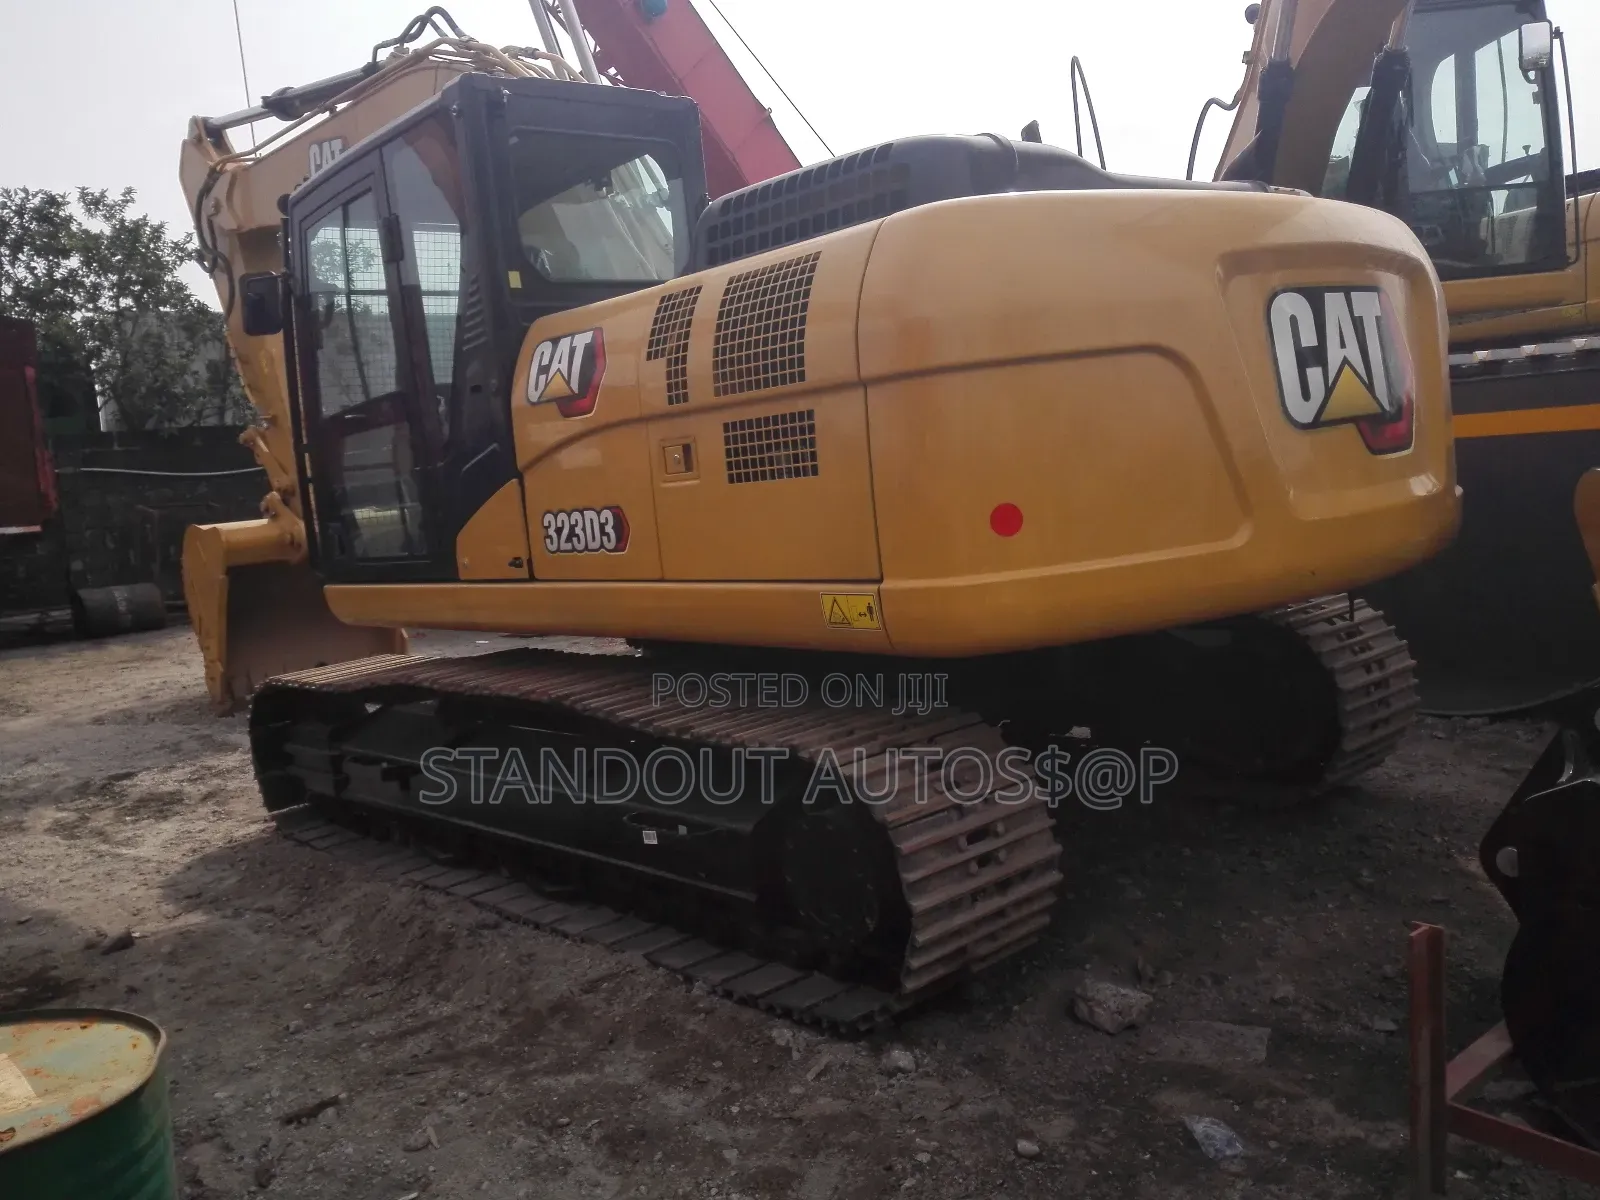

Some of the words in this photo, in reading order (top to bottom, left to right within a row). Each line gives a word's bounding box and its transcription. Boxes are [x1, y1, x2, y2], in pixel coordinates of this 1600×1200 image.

[527, 330, 594, 403] CAT
[1270, 291, 1390, 424] CAT
[543, 508, 617, 551] 323D3
